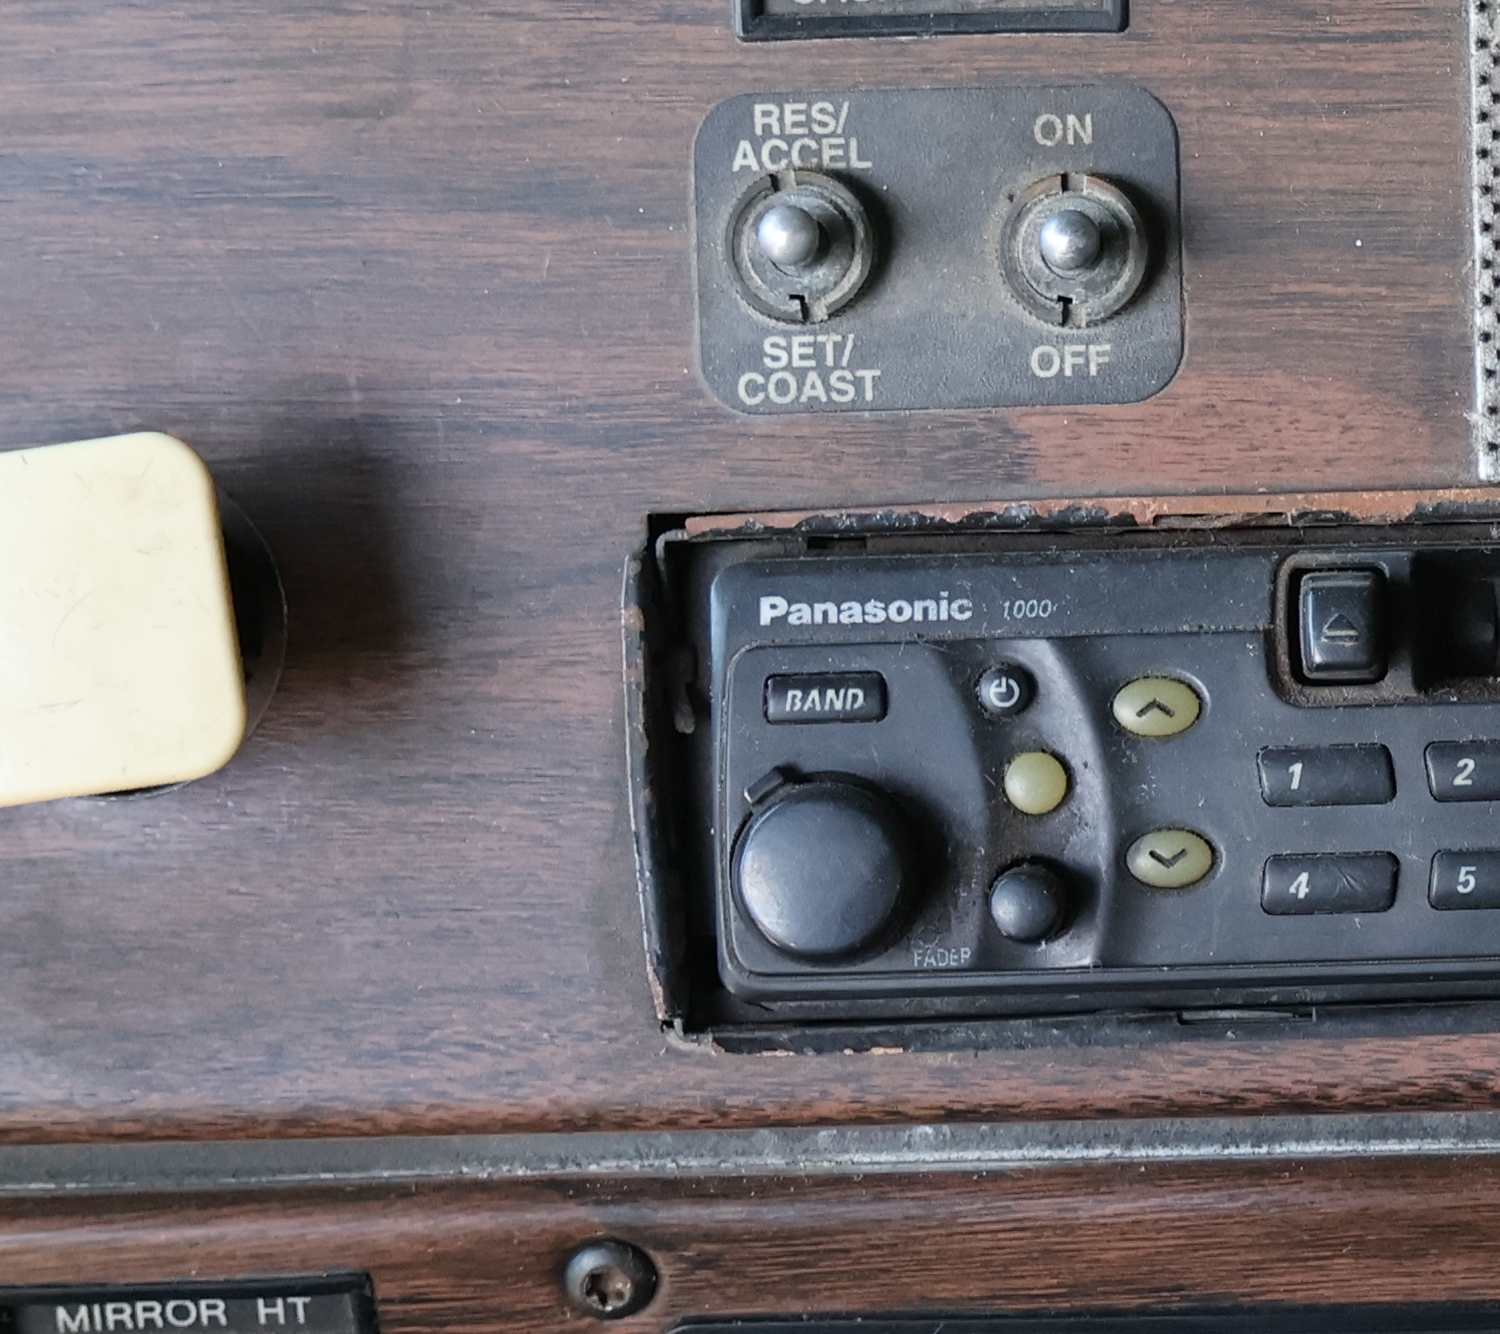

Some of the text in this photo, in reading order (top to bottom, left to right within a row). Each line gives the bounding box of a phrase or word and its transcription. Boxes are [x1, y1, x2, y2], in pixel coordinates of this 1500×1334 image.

[753, 101, 850, 136] RES/
[1033, 113, 1093, 147] ON
[731, 137, 872, 172] ACCEL
[762, 333, 854, 368] SET/
[1030, 343, 1111, 379] OFF
[737, 369, 881, 405] COAST
[759, 590, 974, 627] Panasonic
[784, 686, 865, 713] BAND
[1288, 762, 1303, 791] 1
[1453, 758, 1476, 788] 2
[1289, 871, 1310, 900] 4
[1456, 866, 1477, 895] 5
[255, 1296, 312, 1327] HT
